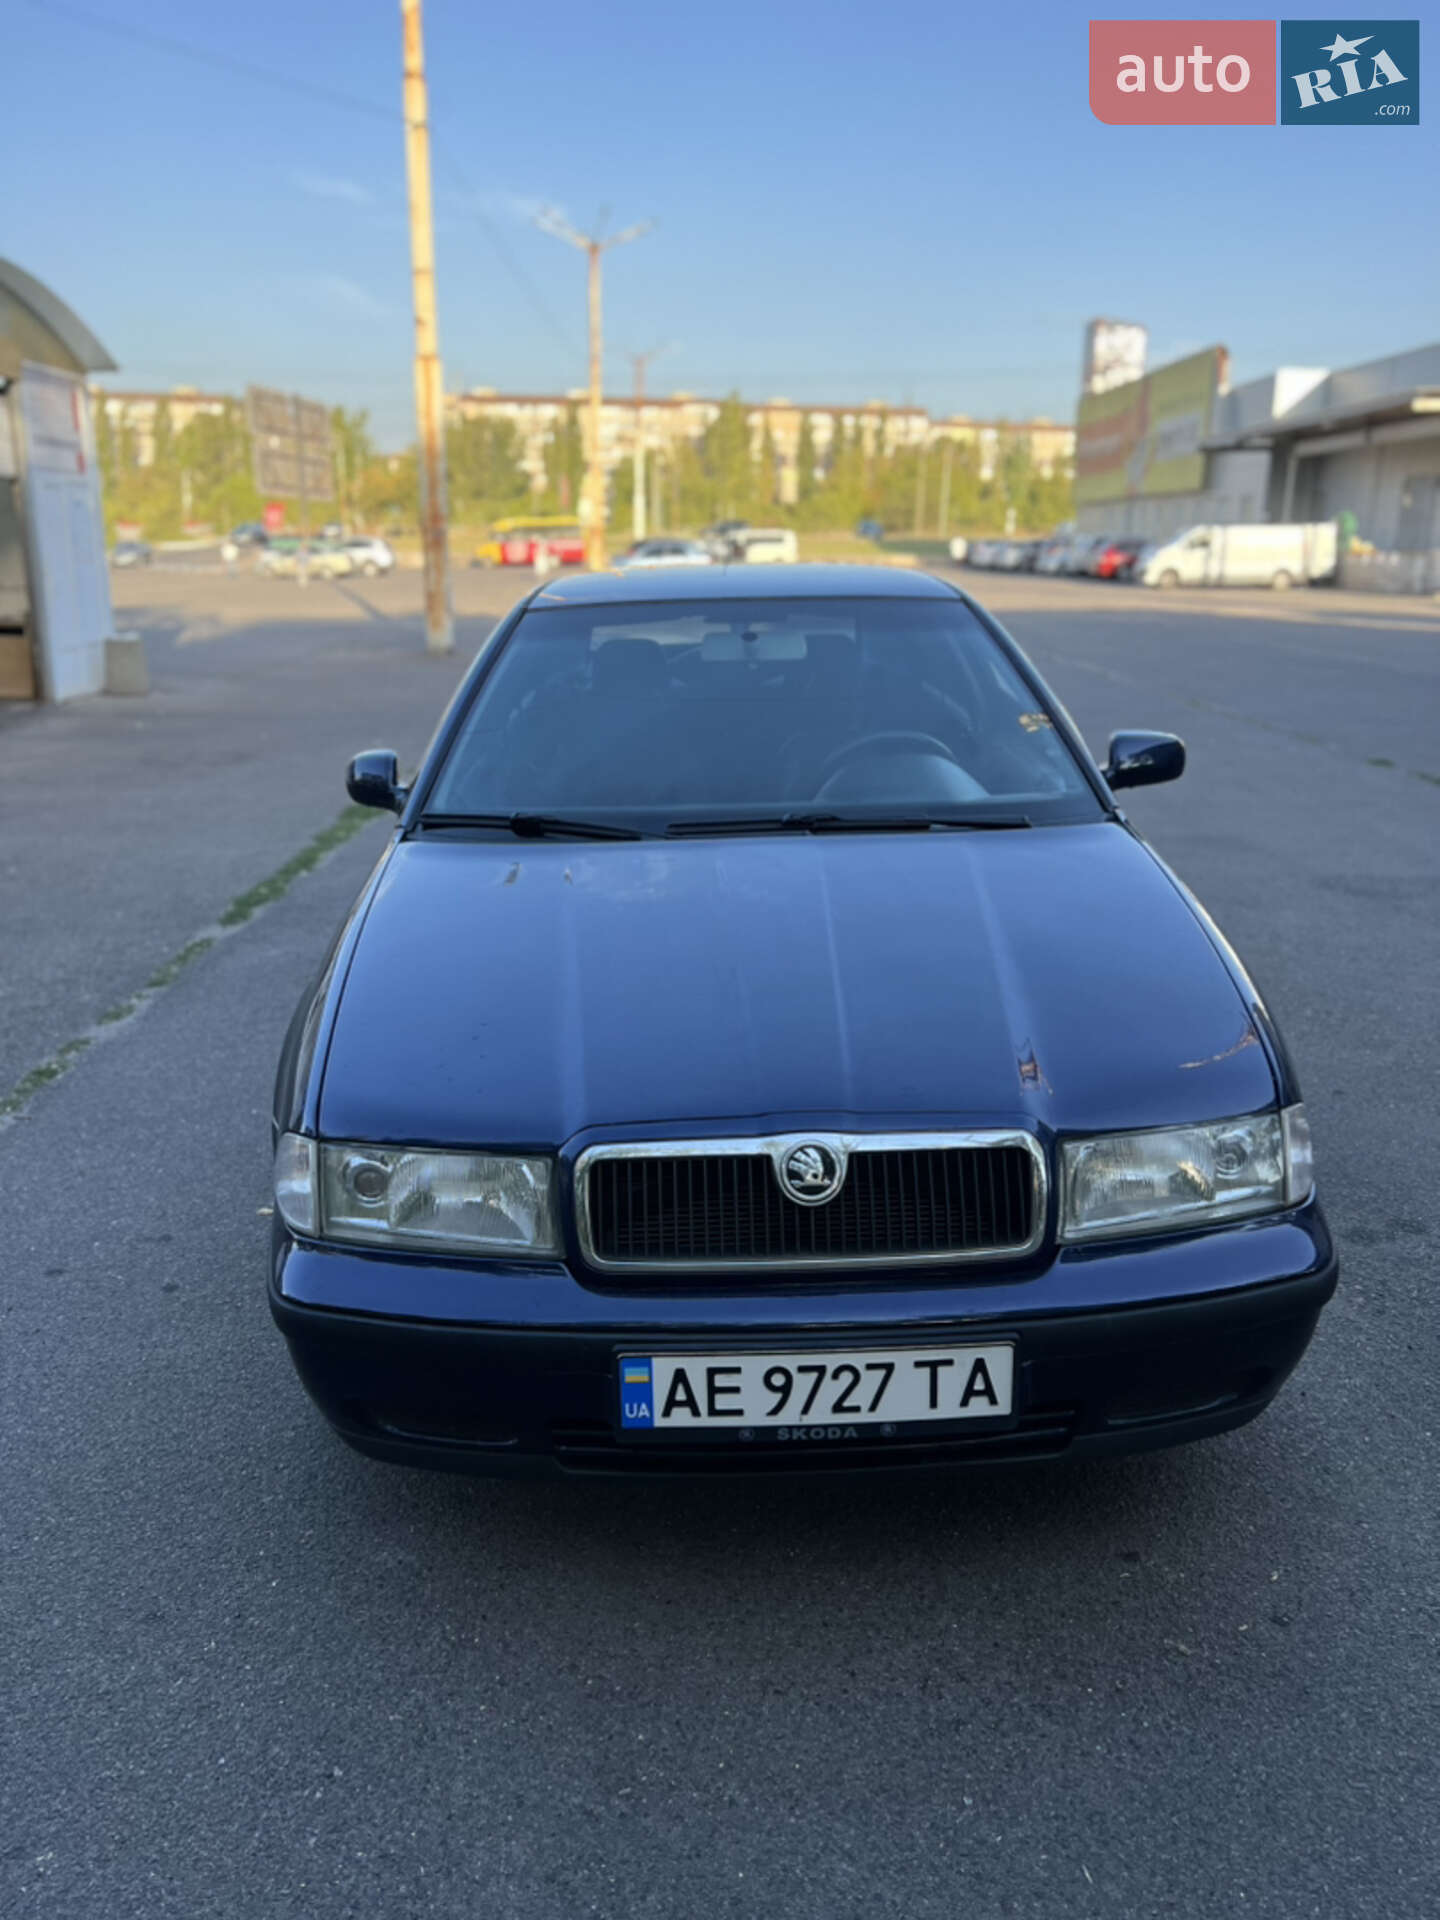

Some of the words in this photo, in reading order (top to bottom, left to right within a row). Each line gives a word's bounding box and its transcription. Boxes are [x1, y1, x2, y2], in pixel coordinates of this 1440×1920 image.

[661, 1366, 745, 1418] AE
[762, 1361, 896, 1417] 9727
[913, 1357, 999, 1409] TA
[624, 1402, 651, 1419] UA
